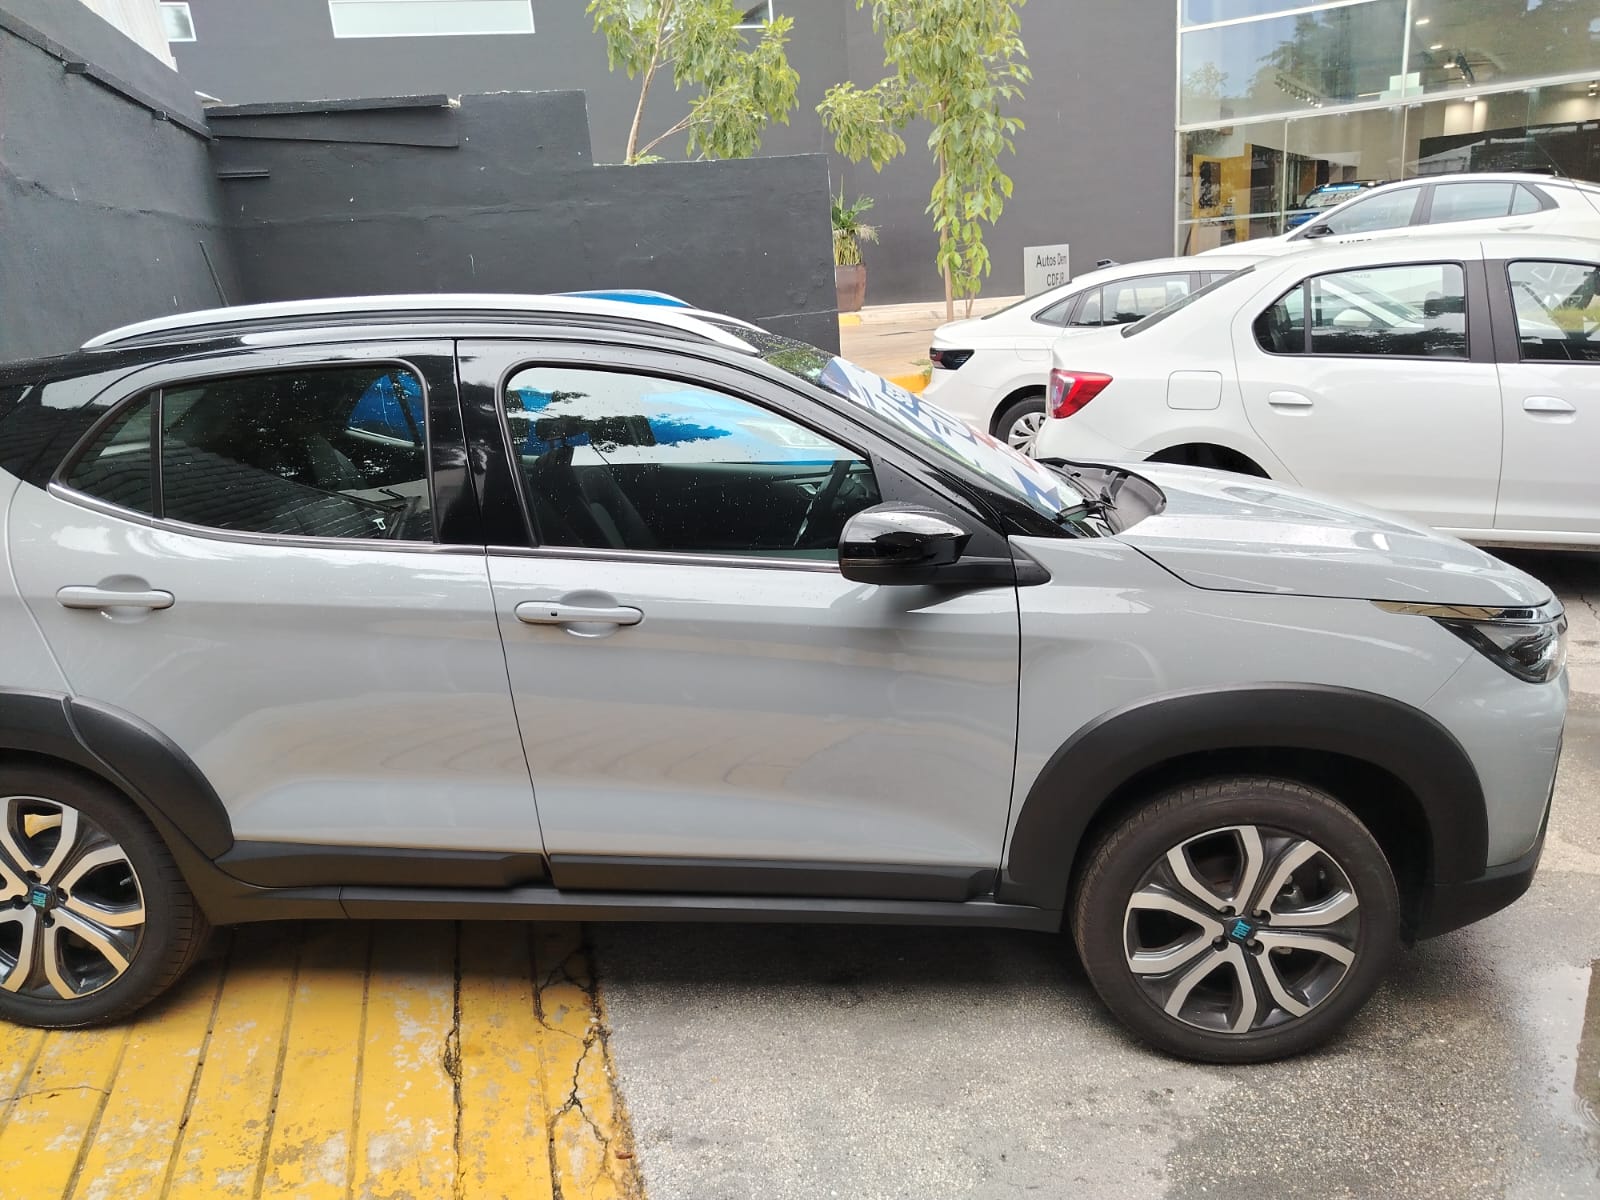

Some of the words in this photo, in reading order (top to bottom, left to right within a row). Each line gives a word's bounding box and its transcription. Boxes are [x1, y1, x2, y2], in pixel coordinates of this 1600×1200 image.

[1036, 254, 1057, 268] Autos
[32, 890, 47, 908] FIAT
[1231, 919, 1252, 941] FIAT
